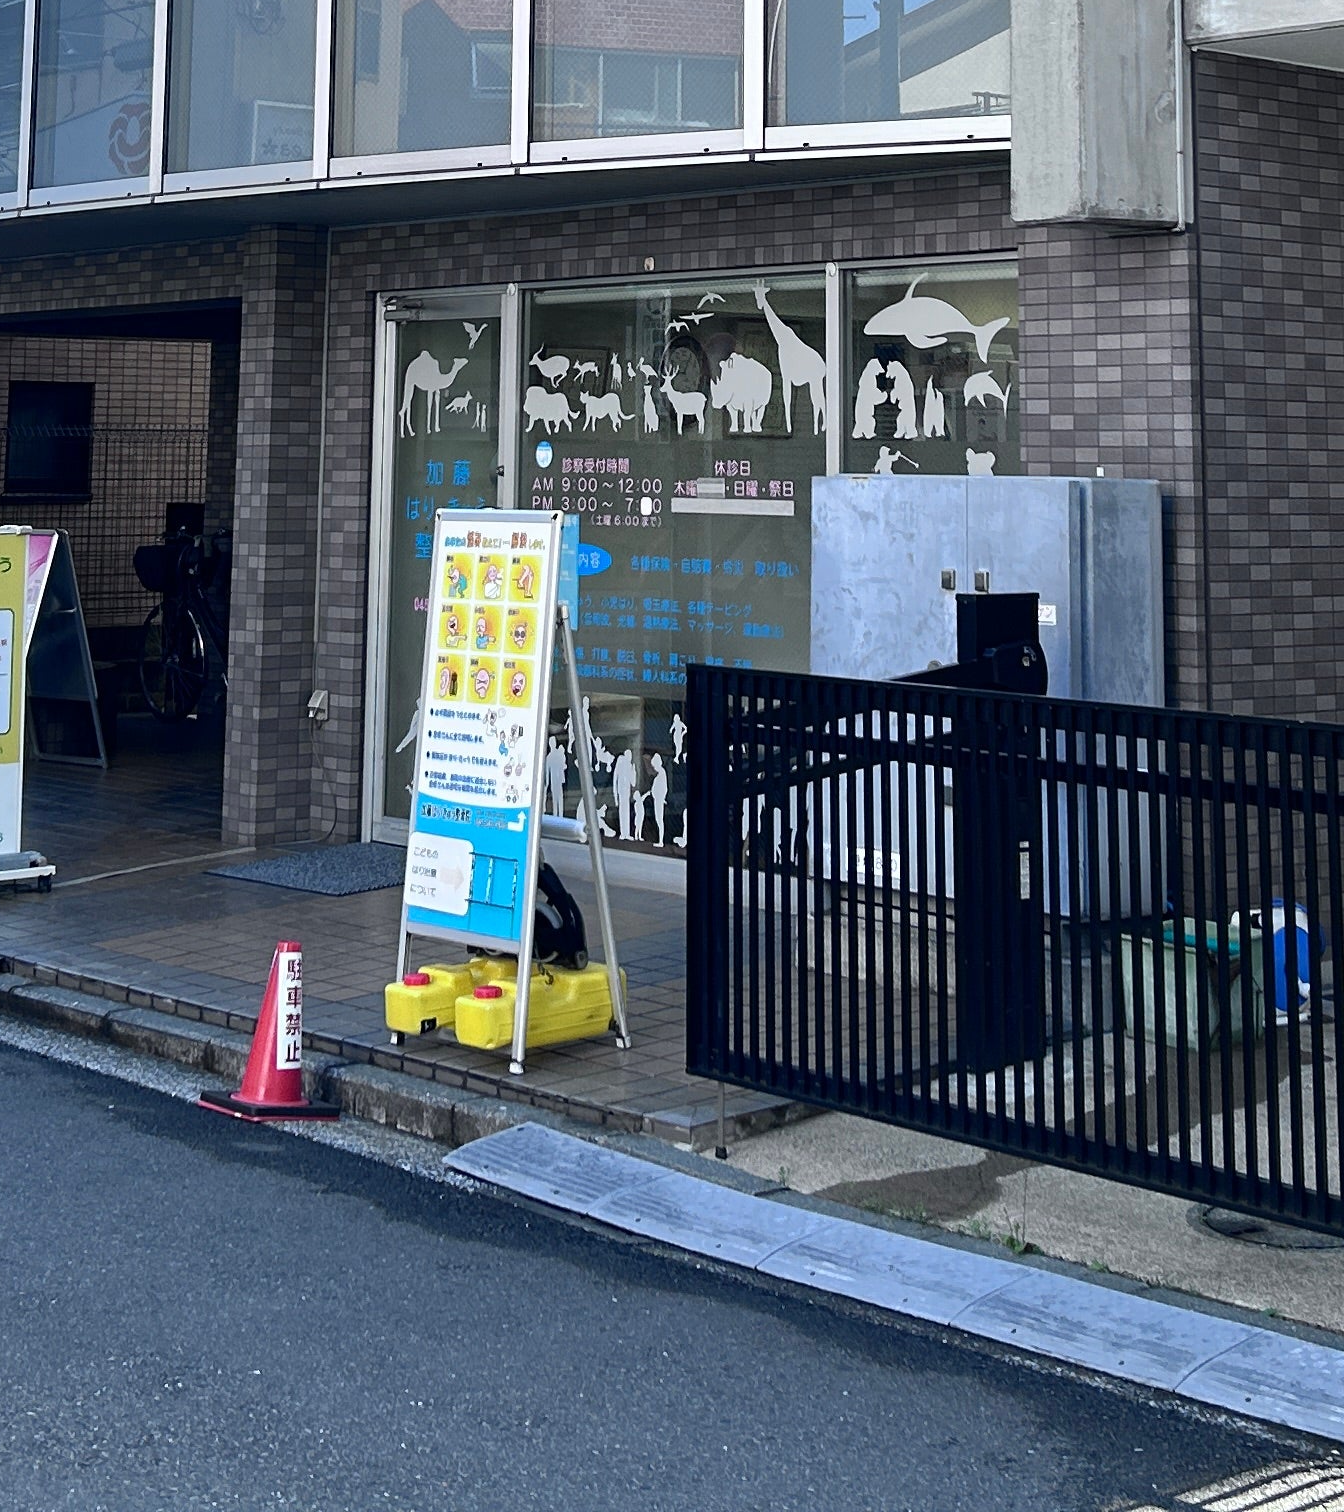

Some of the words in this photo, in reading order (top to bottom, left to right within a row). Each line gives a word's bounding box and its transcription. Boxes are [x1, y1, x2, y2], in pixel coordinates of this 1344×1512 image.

[561, 457, 630, 474] 診察受付時間
[714, 460, 751, 477] 休診日
[532, 476, 554, 492] AM
[532, 495, 553, 510] PM
[625, 497, 662, 514] 7:0
[285, 958, 302, 1064] 駐車禁止
